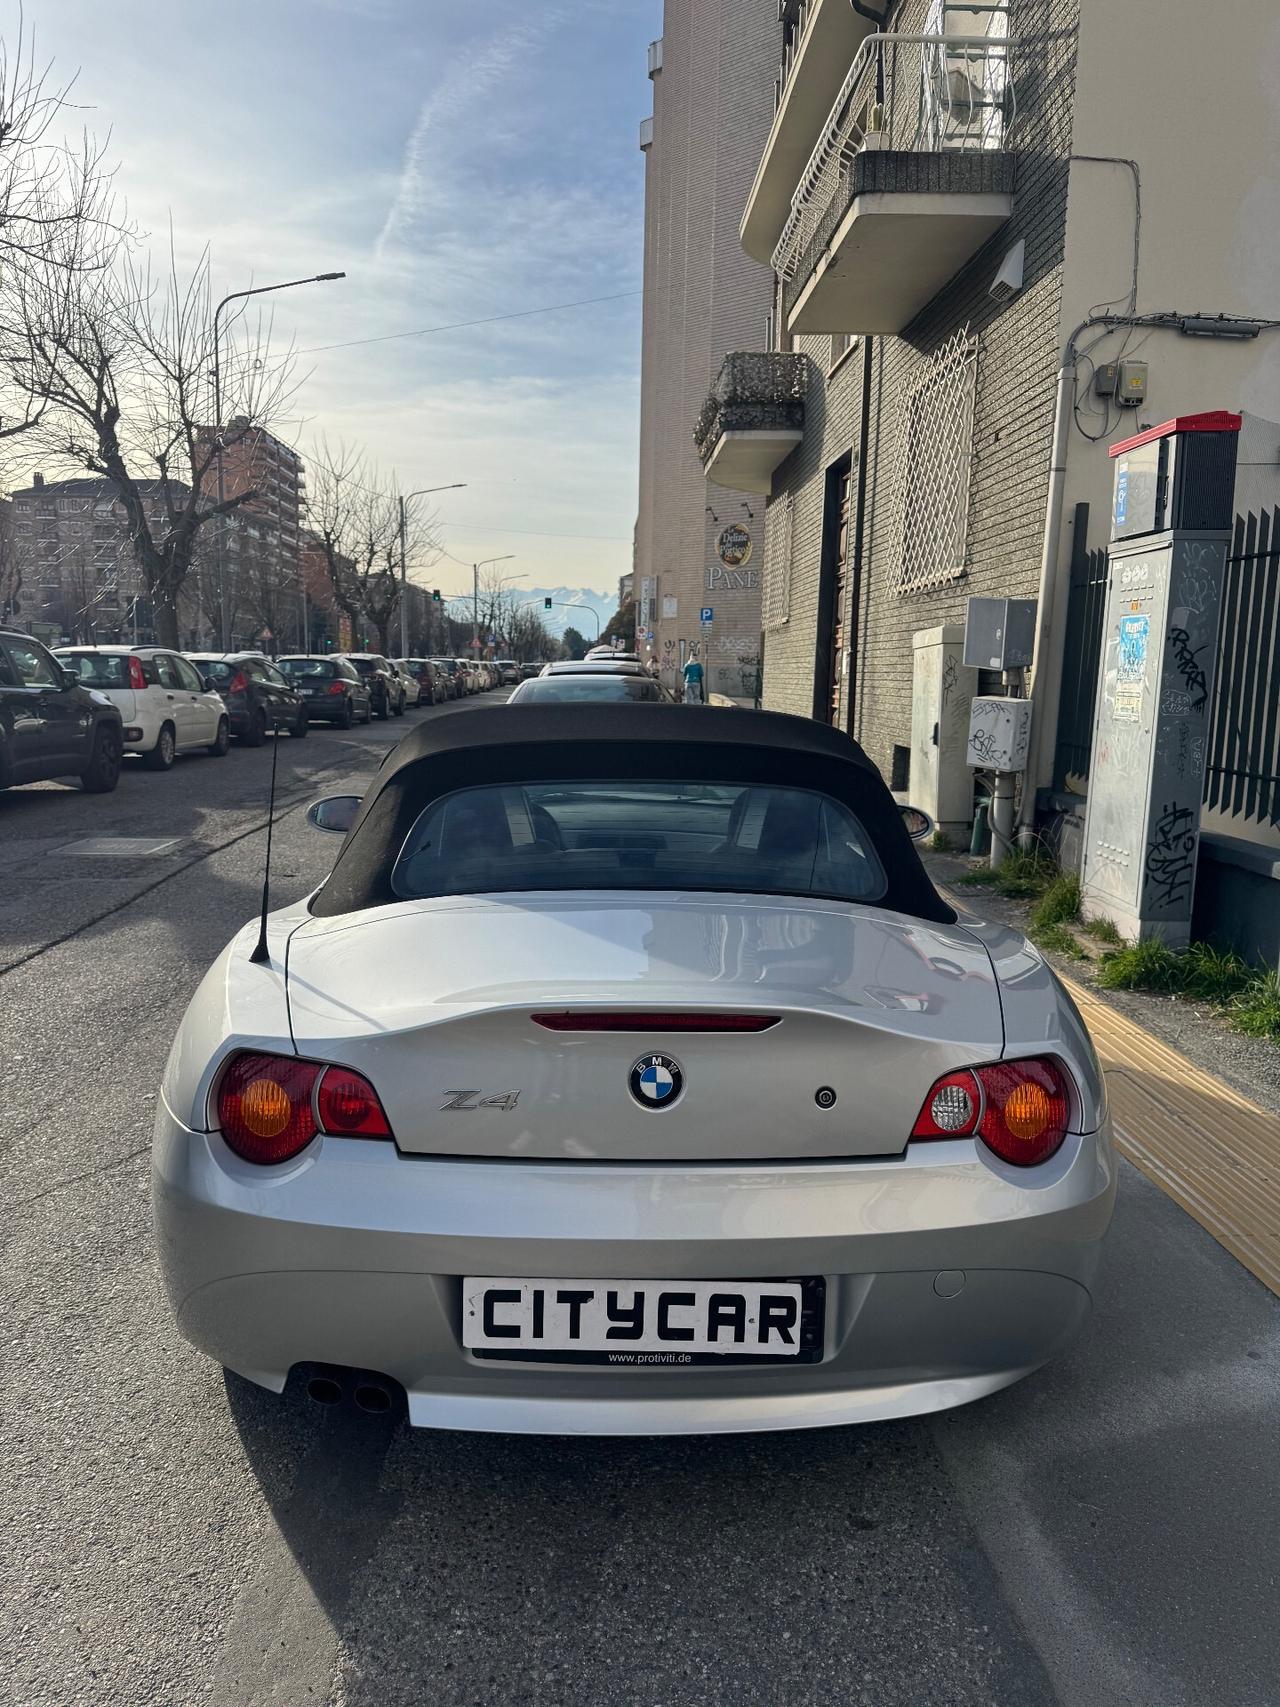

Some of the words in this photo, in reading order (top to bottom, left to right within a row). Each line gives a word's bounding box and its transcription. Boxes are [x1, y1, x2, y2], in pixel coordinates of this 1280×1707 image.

[707, 567, 758, 590] PANE
[702, 609, 711, 620] P
[438, 1088, 523, 1112] Z4
[483, 1289, 798, 1345] CITYCAR
[608, 1353, 692, 1364] www.protiviti.de
